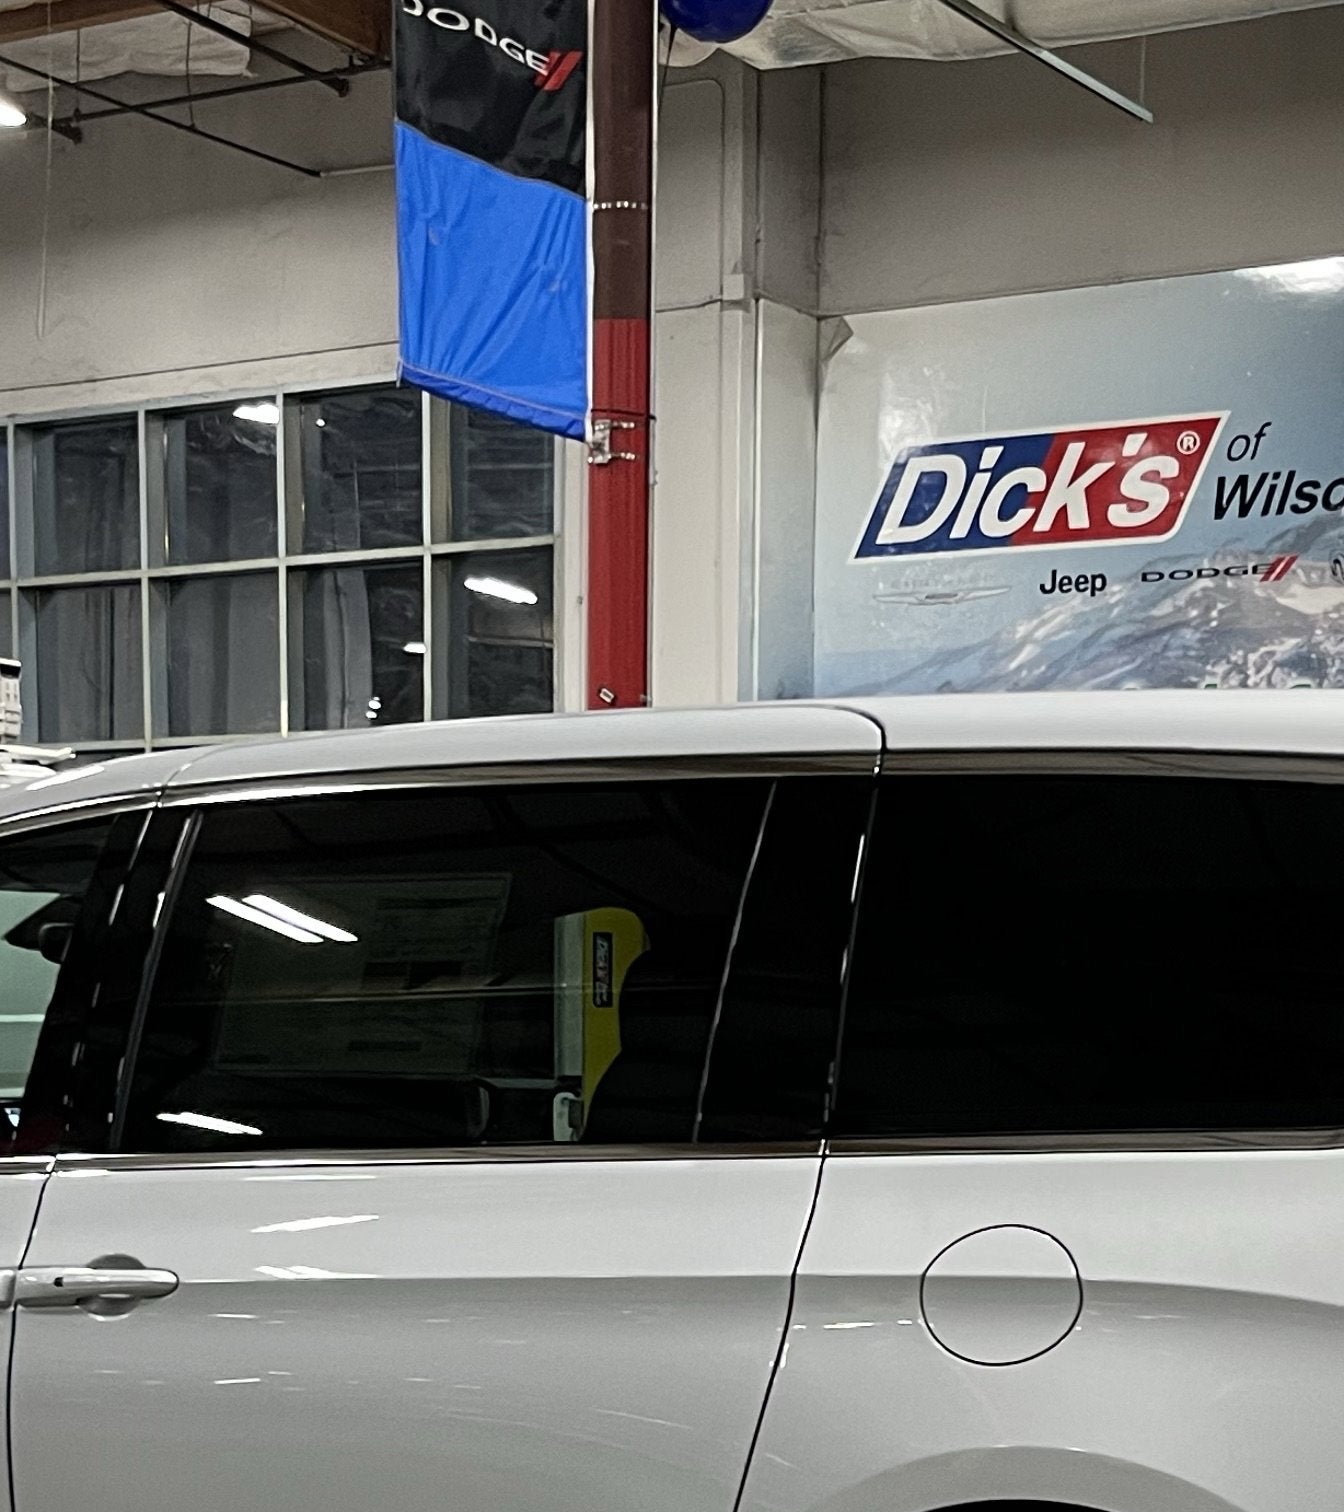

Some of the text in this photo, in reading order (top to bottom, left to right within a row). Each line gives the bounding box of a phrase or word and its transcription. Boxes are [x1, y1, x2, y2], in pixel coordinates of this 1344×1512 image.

[403, 0, 549, 76] DODGE
[875, 422, 1272, 545] Dick's of
[1039, 569, 1106, 596] Jeep
[1141, 563, 1278, 582] DODGE
